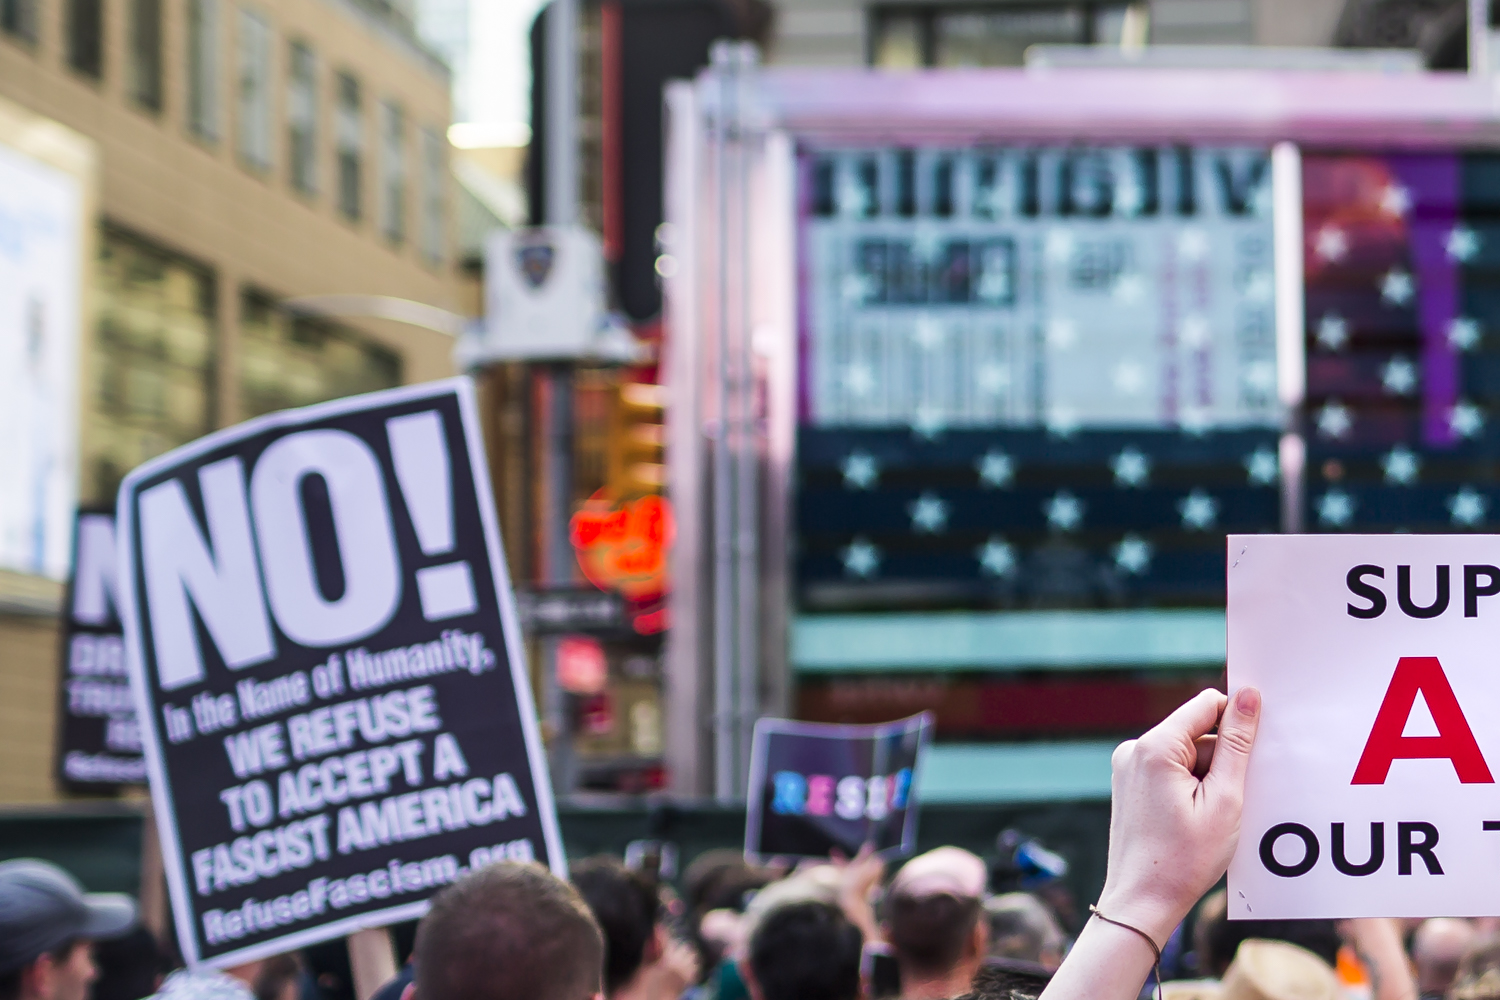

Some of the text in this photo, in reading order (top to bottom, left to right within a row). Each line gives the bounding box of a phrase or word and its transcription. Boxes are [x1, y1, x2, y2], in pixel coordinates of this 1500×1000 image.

[138, 408, 478, 692] NO!
[162, 703, 194, 744] In
[192, 690, 236, 735] the
[236, 671, 310, 720] Name
[312, 653, 346, 699] of
[346, 629, 496, 690] Humanity,
[222, 721, 288, 779] WE
[287, 685, 442, 759] REFUSE
[192, 772, 527, 895] FASCIST AMERICA
[220, 732, 468, 831] TO ACCEPT A
[1258, 820, 1445, 879] OUR
